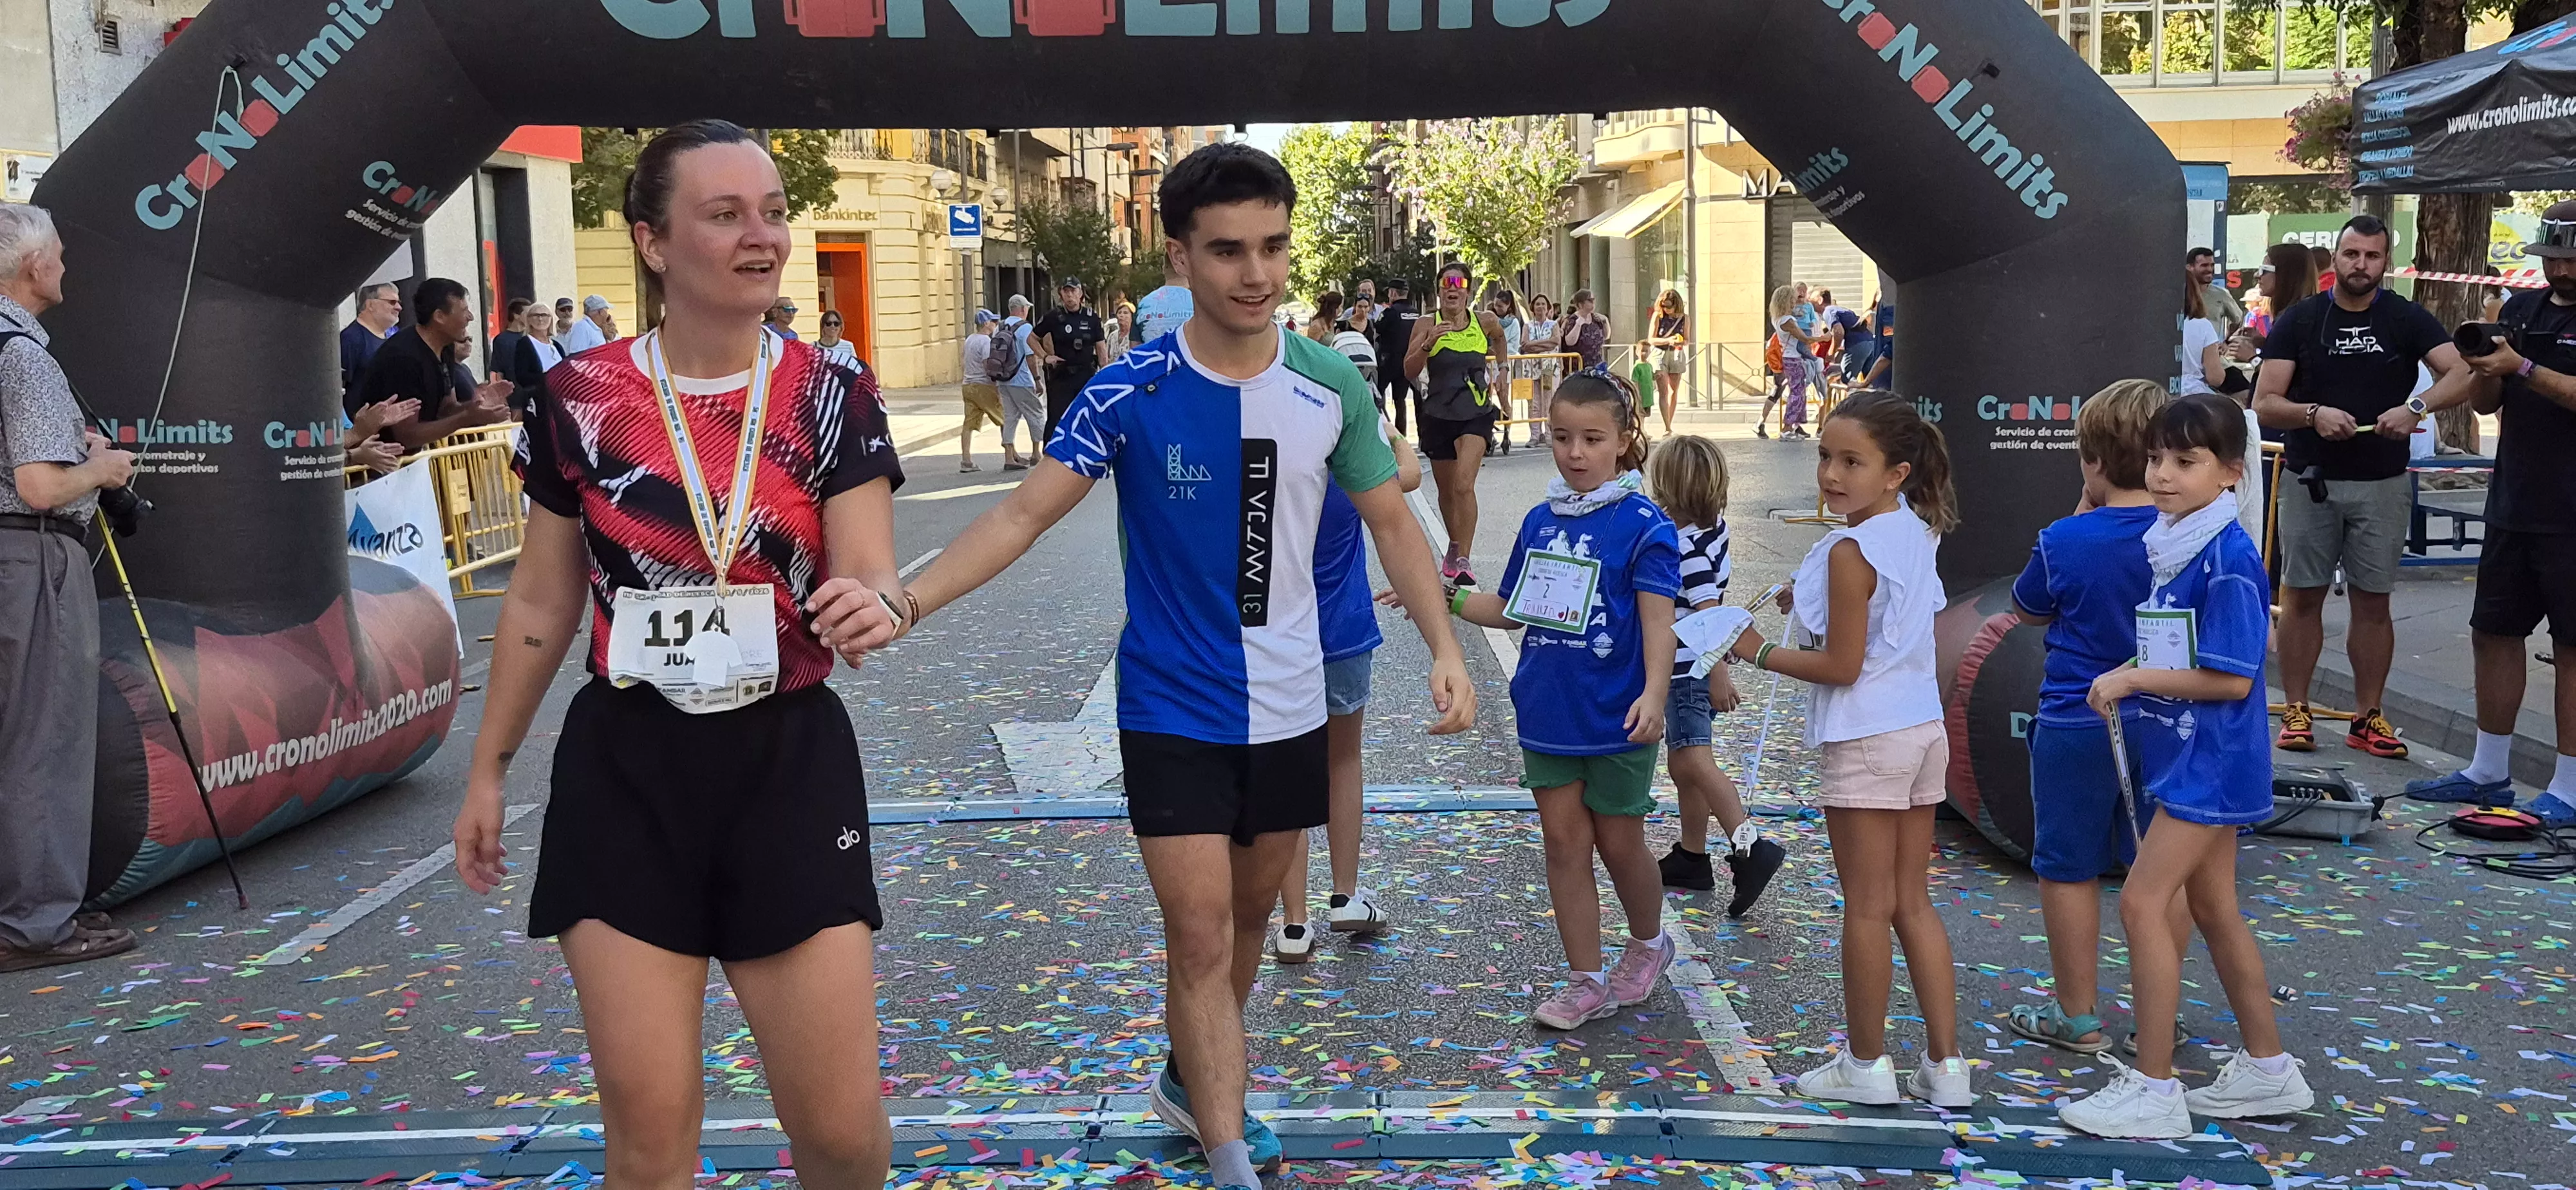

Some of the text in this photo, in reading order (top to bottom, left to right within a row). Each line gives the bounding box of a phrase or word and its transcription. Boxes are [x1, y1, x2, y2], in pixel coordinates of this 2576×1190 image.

[1995, 426, 2035, 437] Servicio
[2038, 425, 2051, 437] de
[1990, 439, 2027, 450] gestión
[2030, 439, 2043, 450] de
[198, 452, 206, 462] y
[285, 455, 316, 466] Servicio
[158, 463, 219, 474] deportivos
[281, 469, 312, 481] gestión
[1168, 485, 1197, 500] 21K
[1242, 592, 1262, 614] 31
[196, 677, 452, 797] www.cronolimits2020.com
